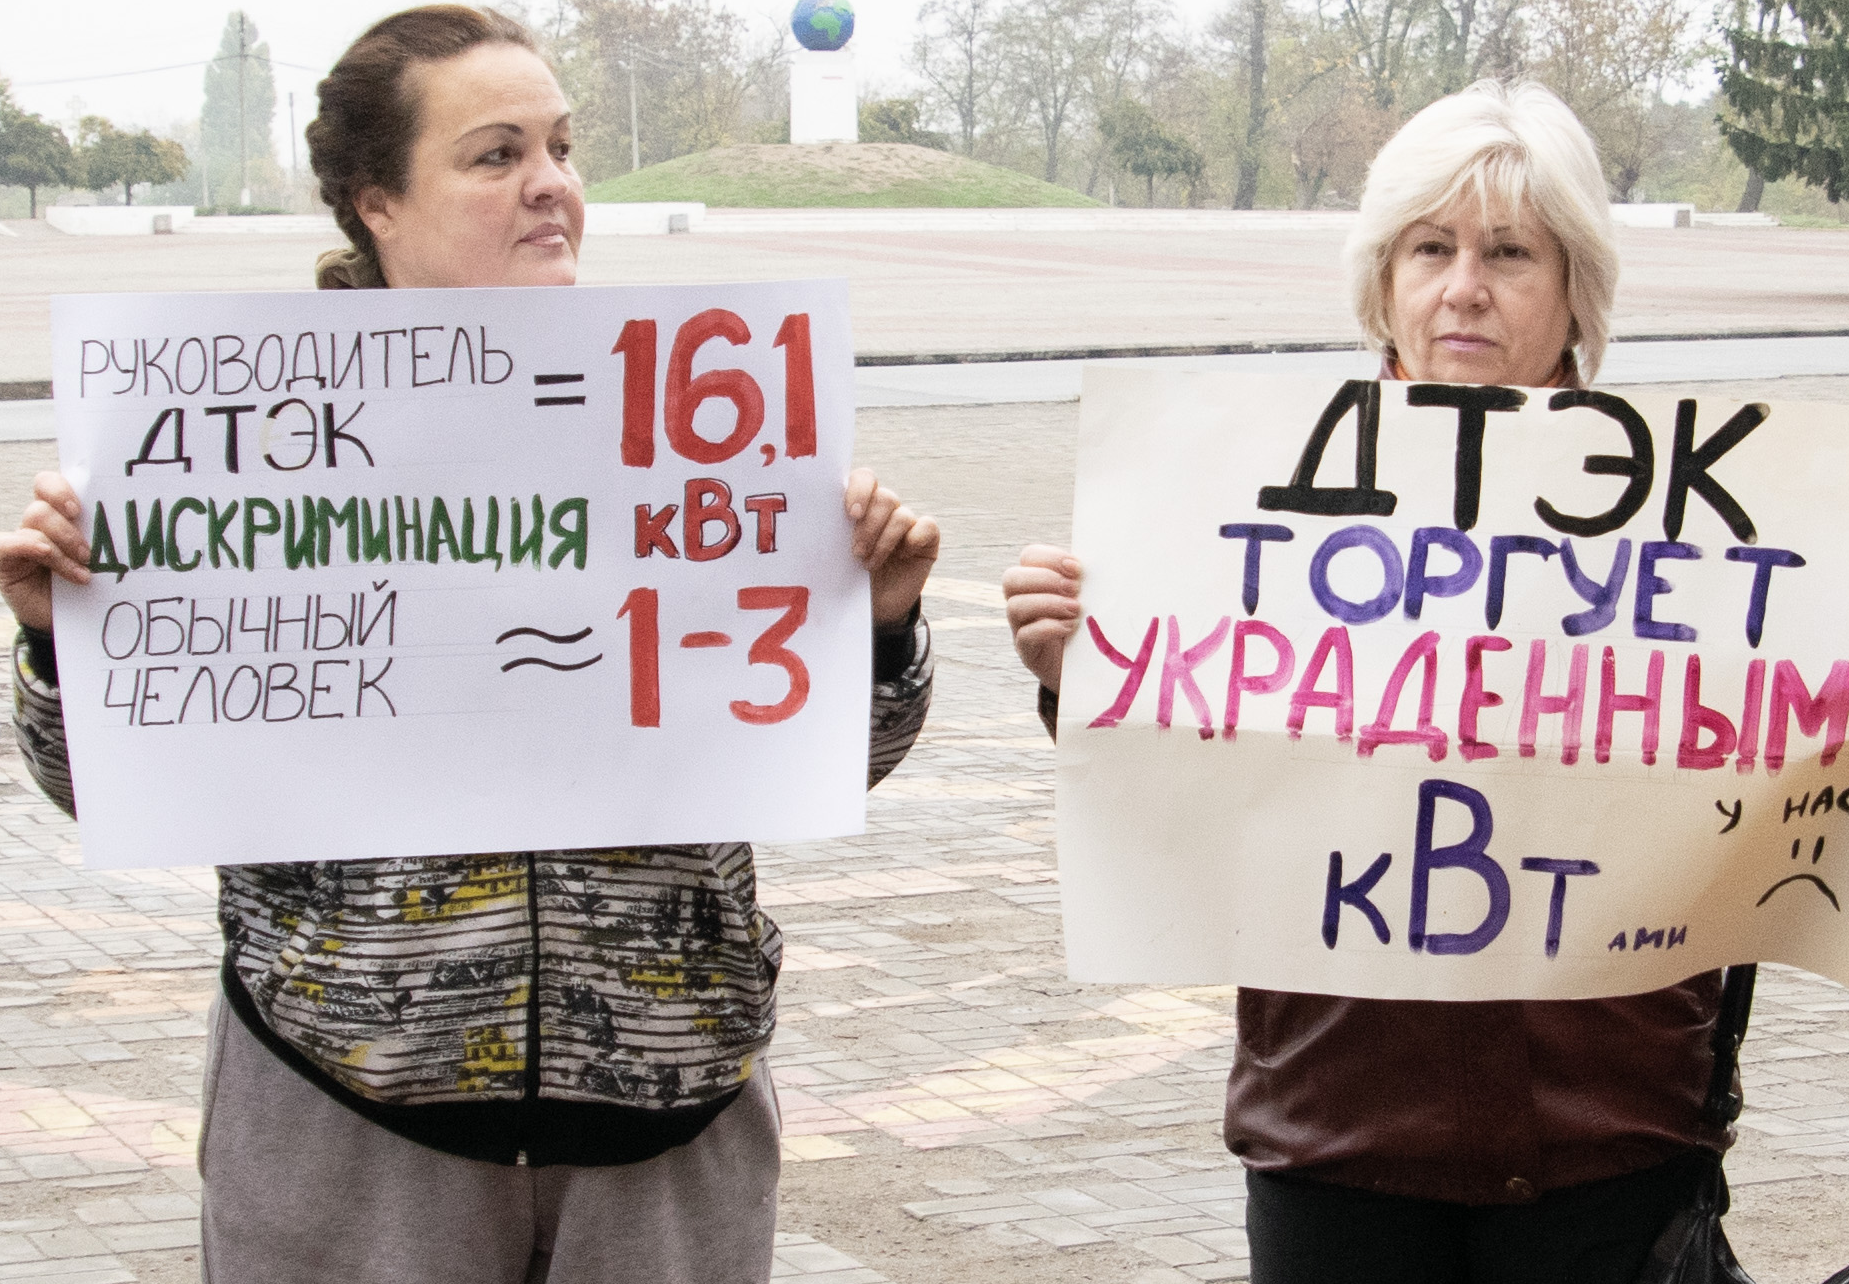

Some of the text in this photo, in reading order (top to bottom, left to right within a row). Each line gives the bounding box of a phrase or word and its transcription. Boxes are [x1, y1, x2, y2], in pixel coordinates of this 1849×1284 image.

[79, 325, 514, 399] РУКОВОДИТЕЛЬ
[611, 307, 818, 469] 16,1
[124, 398, 376, 477] ДТЭК
[1257, 379, 1771, 546] ДТЭК
[88, 494, 589, 584] ДИСКРИМИНАЦИЯ
[101, 578, 398, 662] ОБЫЧНЫЙ
[1219, 523, 1807, 650] ТОРГУЕТ
[102, 653, 398, 727] ЧЕЛОВЕК
